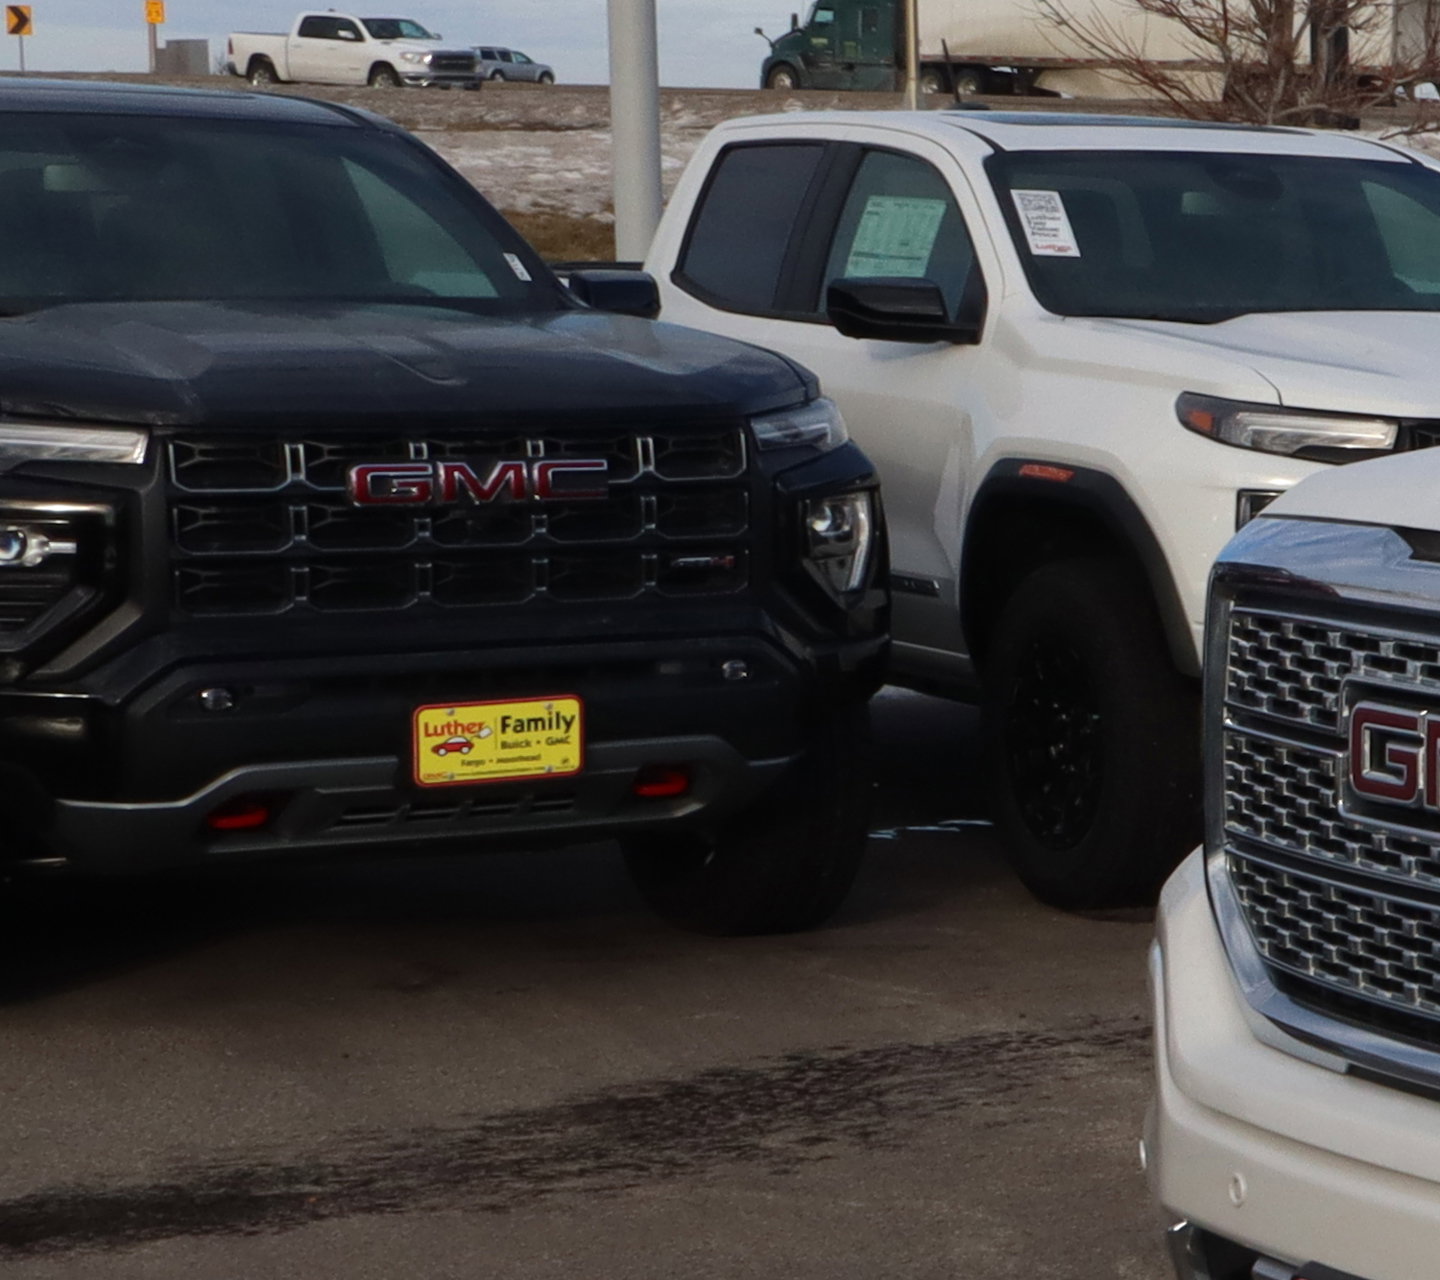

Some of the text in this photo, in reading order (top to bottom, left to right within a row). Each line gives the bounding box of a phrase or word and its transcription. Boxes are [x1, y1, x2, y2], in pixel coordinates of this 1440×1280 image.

[349, 459, 608, 507] GMC
[424, 711, 576, 738] Luther Family
[500, 735, 571, 750] Buick GMC
